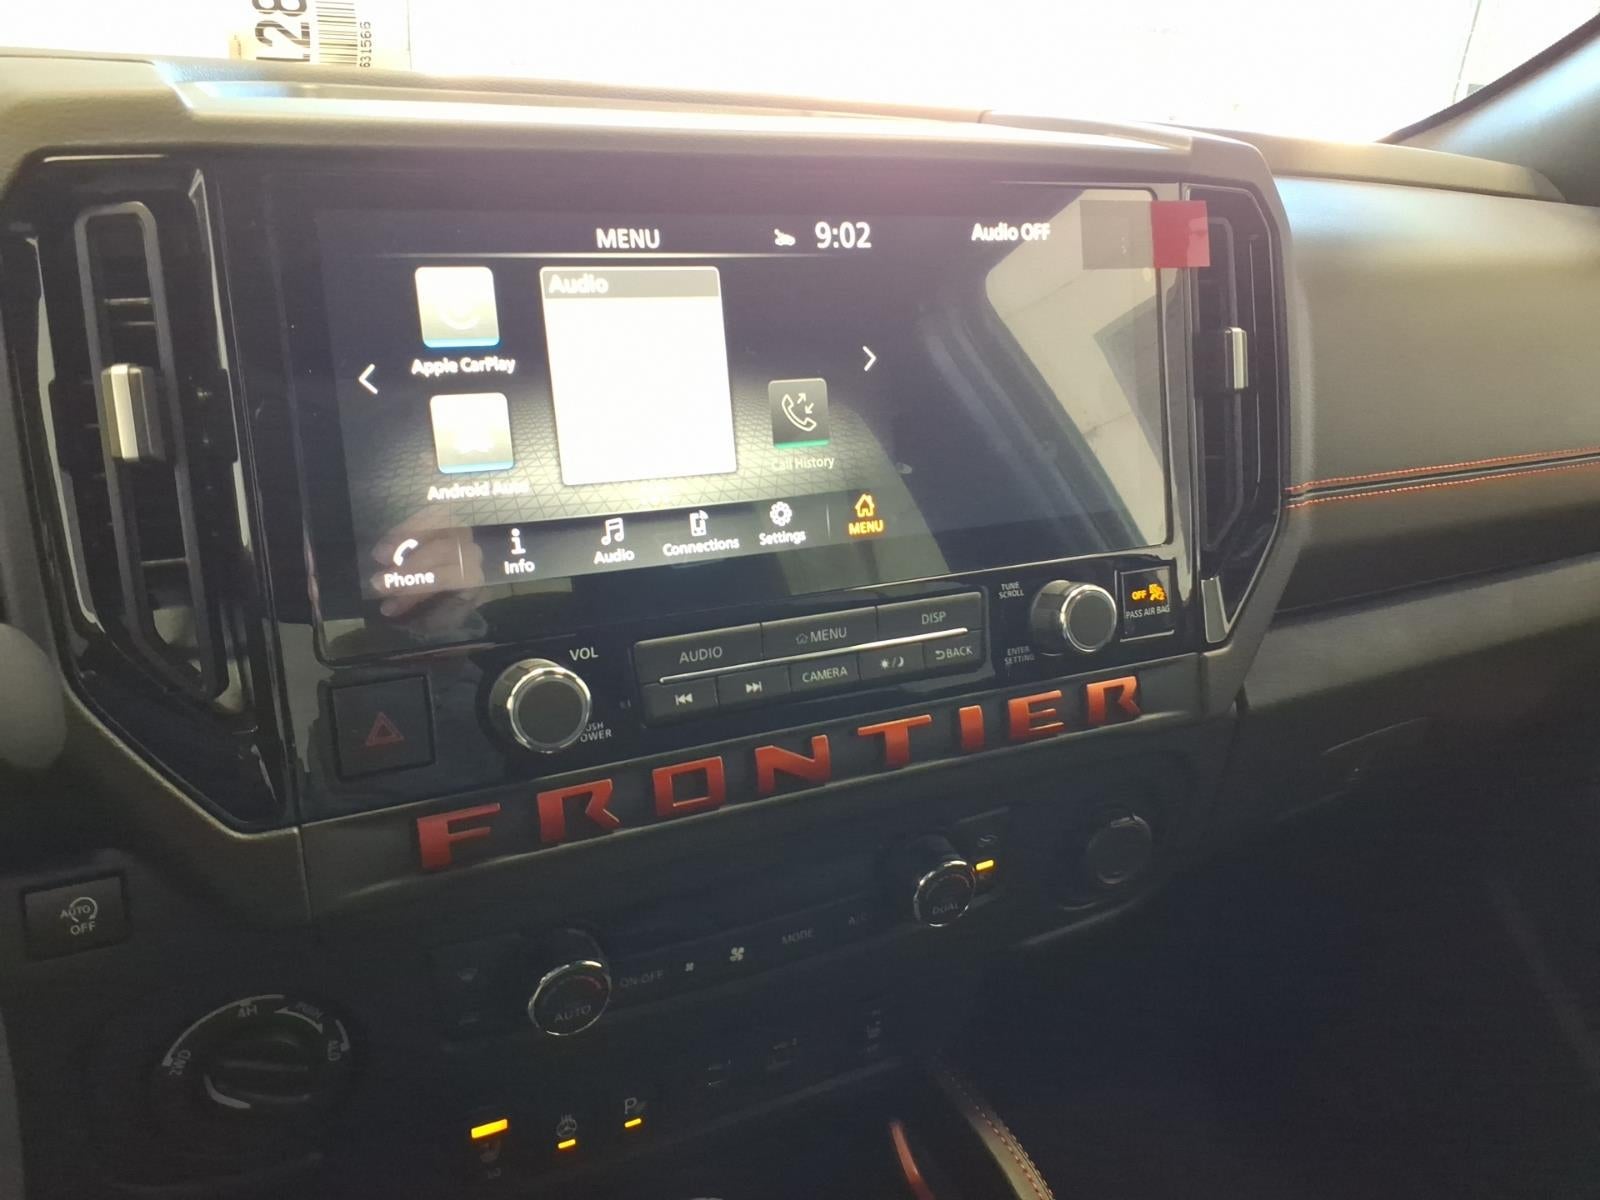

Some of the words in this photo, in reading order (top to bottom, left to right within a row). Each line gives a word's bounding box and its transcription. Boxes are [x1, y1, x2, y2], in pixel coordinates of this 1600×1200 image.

[595, 228, 662, 250] MENU
[814, 221, 873, 249] 9:02
[971, 222, 1018, 242] Audio
[1020, 222, 1051, 241] OFF
[548, 273, 609, 296] Audio
[411, 357, 459, 377] Apple
[459, 355, 516, 375] CarPlay
[795, 457, 835, 470] History
[427, 482, 491, 501] Android
[847, 519, 884, 537] MENU
[758, 530, 807, 547] Settings
[662, 537, 740, 557] Connections
[593, 547, 636, 566] Audio
[504, 560, 536, 576] Info
[384, 570, 435, 590] Phone
[1000, 581, 1021, 591] TUNE
[998, 590, 1025, 600] SCROLL
[1131, 589, 1147, 602] OFF
[920, 611, 947, 626] DISP
[1125, 609, 1143, 619] PASS
[1144, 607, 1156, 617] AIR
[1156, 605, 1171, 615] BAG
[809, 628, 848, 644] MENU
[569, 646, 599, 662] VOL
[679, 646, 724, 665] AUDIO
[946, 645, 973, 660] BACK
[1006, 645, 1031, 657] ENTER
[1003, 654, 1037, 665] SETTING
[802, 666, 848, 684] CAMERA
[585, 721, 605, 733] USH
[579, 728, 613, 744] OWER
[416, 675, 1142, 873] FRONTIER
[60, 904, 92, 920] AUTO
[70, 921, 96, 936] OFF
[781, 928, 815, 945] MODE
[554, 1004, 593, 1024] AUTO
